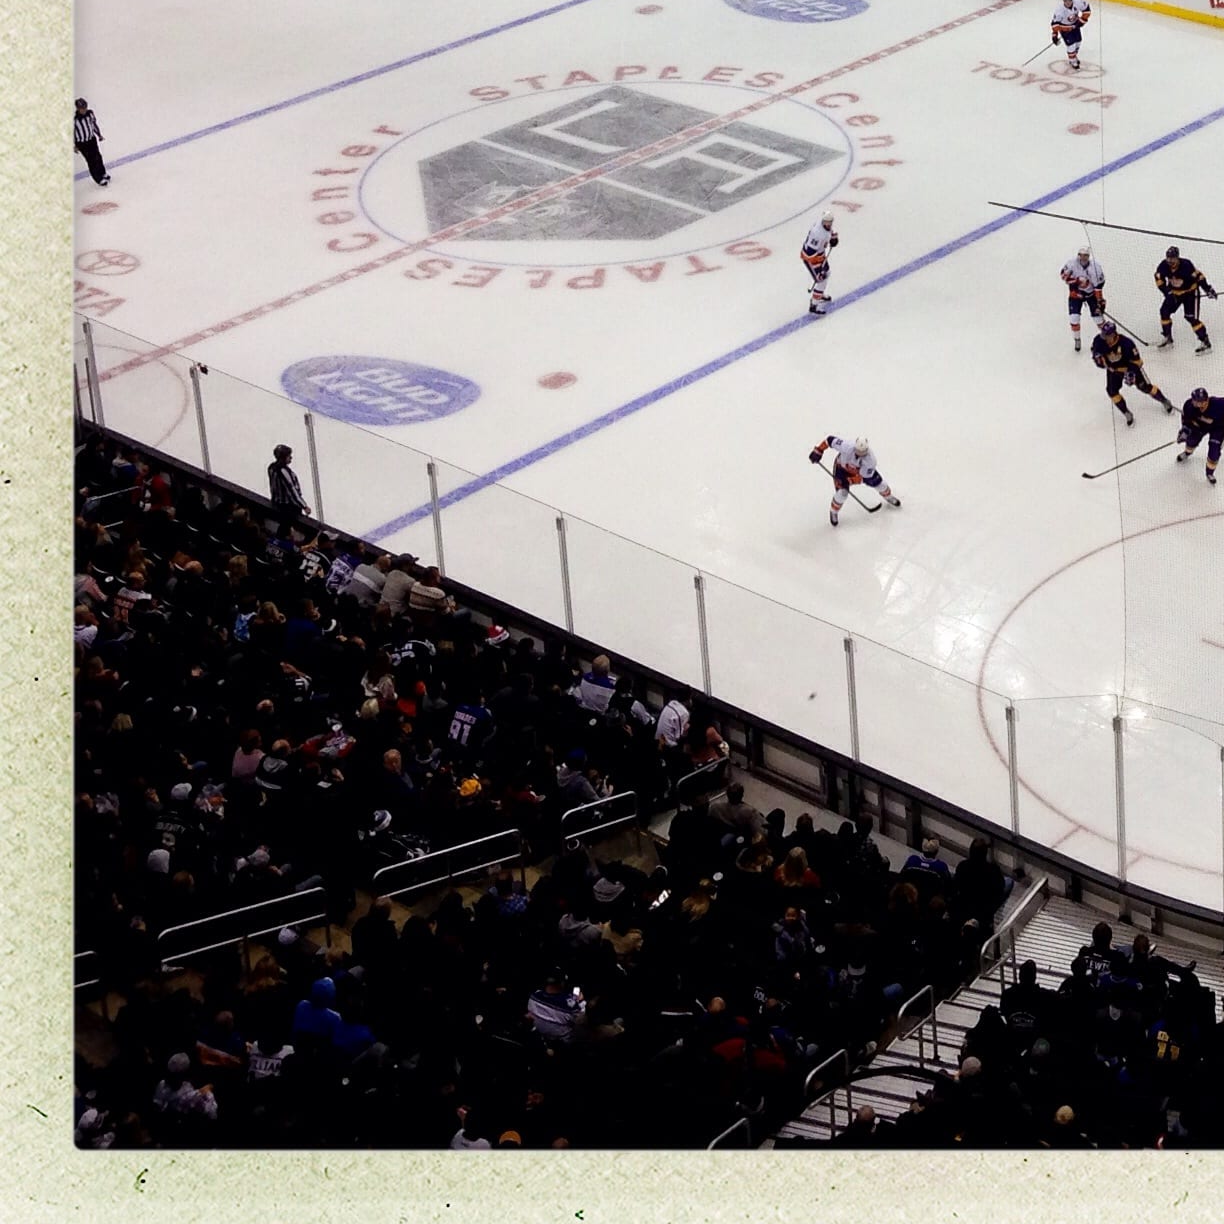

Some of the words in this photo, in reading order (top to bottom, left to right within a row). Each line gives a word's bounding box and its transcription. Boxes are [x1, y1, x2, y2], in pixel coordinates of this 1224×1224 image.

[970, 59, 1119, 109] TOYOTA
[468, 64, 784, 103] STAPLES
[816, 91, 904, 215] Center
[311, 122, 402, 255] Center
[402, 240, 772, 290] STAPLES
